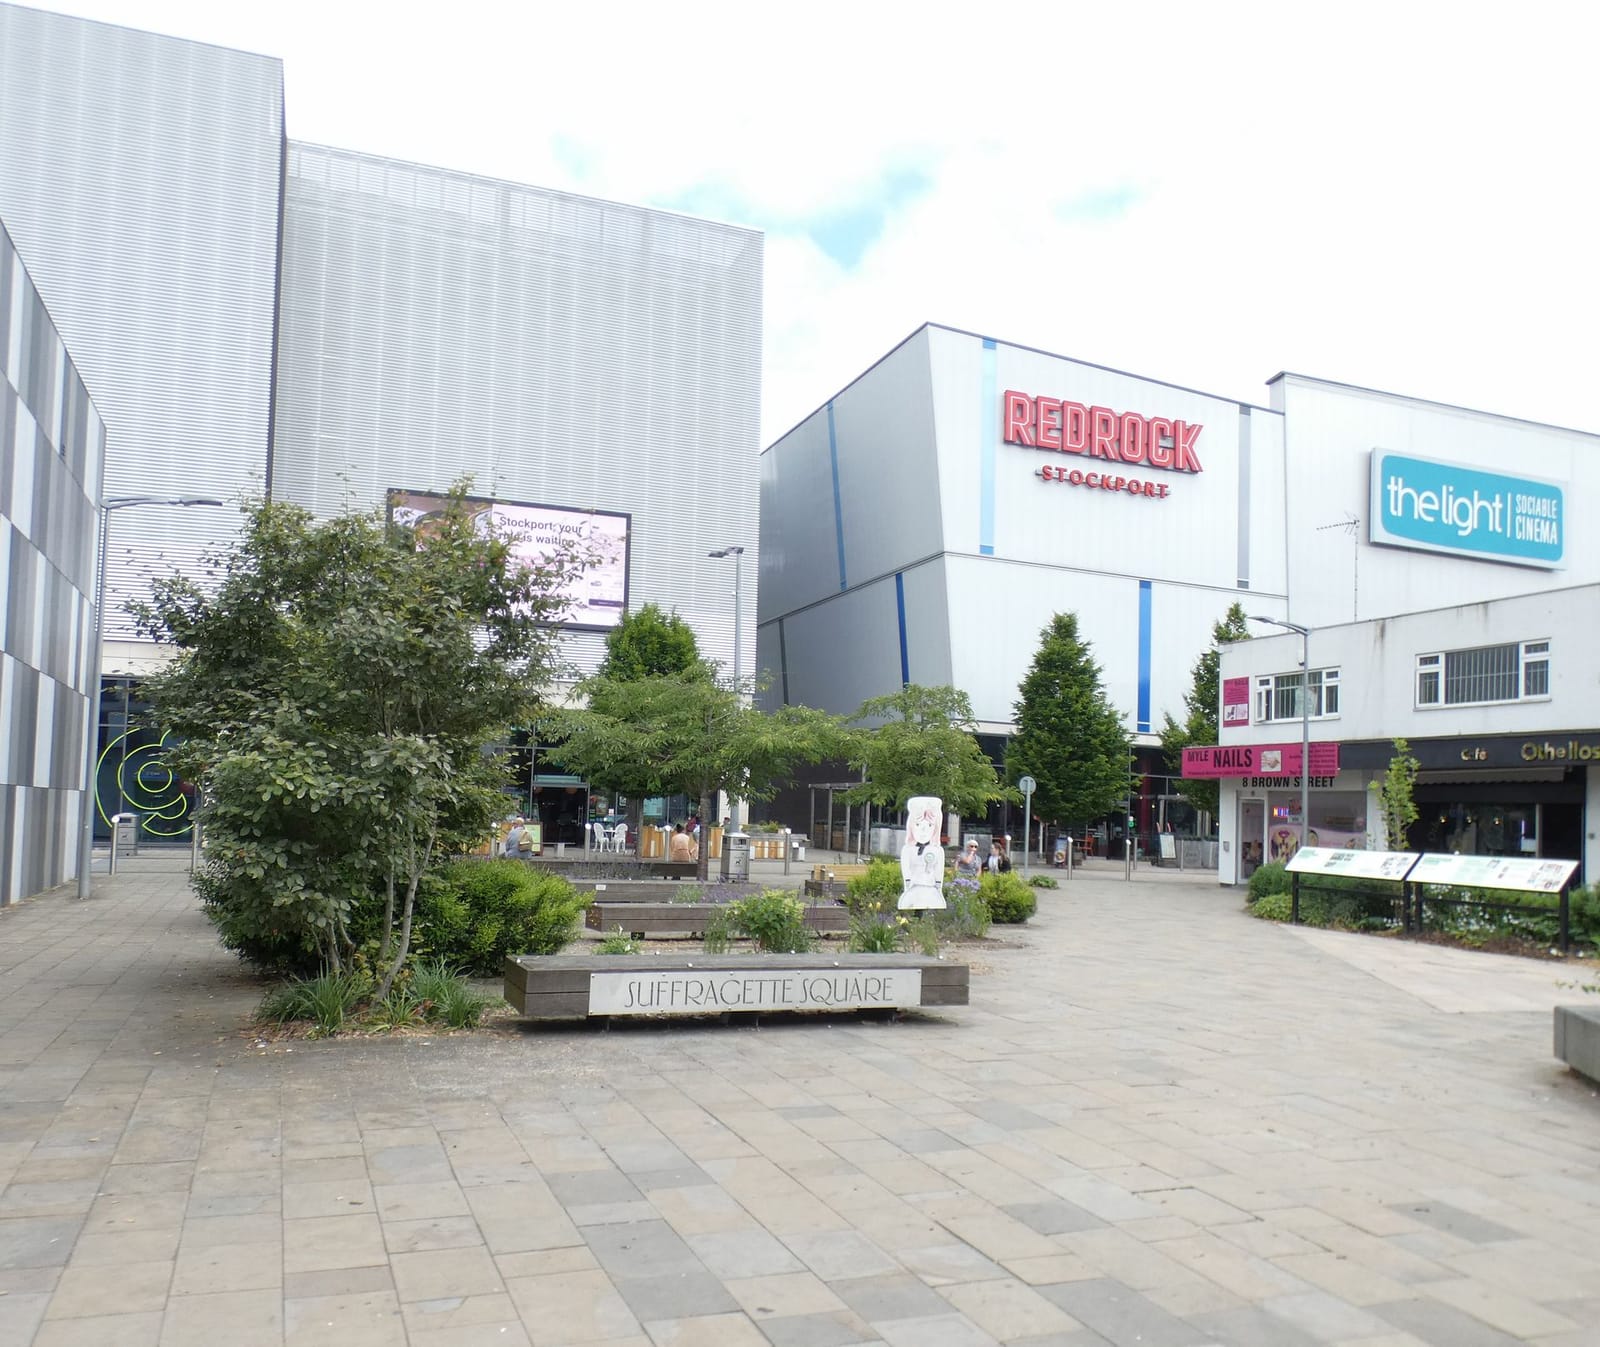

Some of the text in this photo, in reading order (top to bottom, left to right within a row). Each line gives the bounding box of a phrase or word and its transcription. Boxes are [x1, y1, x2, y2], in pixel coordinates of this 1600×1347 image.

[1004, 390, 1204, 473] REDROCK
[1041, 465, 1169, 498] STOCKPORT
[1515, 494, 1557, 519] SOCIABLE
[559, 524, 583, 534] your
[1515, 518, 1558, 545] CINEMA
[1213, 748, 1253, 768] NAILS
[1520, 741, 1600, 762] Othellos
[1242, 776, 1335, 788] 8 BROWN SREET
[624, 976, 894, 1008] SUFFRAGETTE SQUARE
